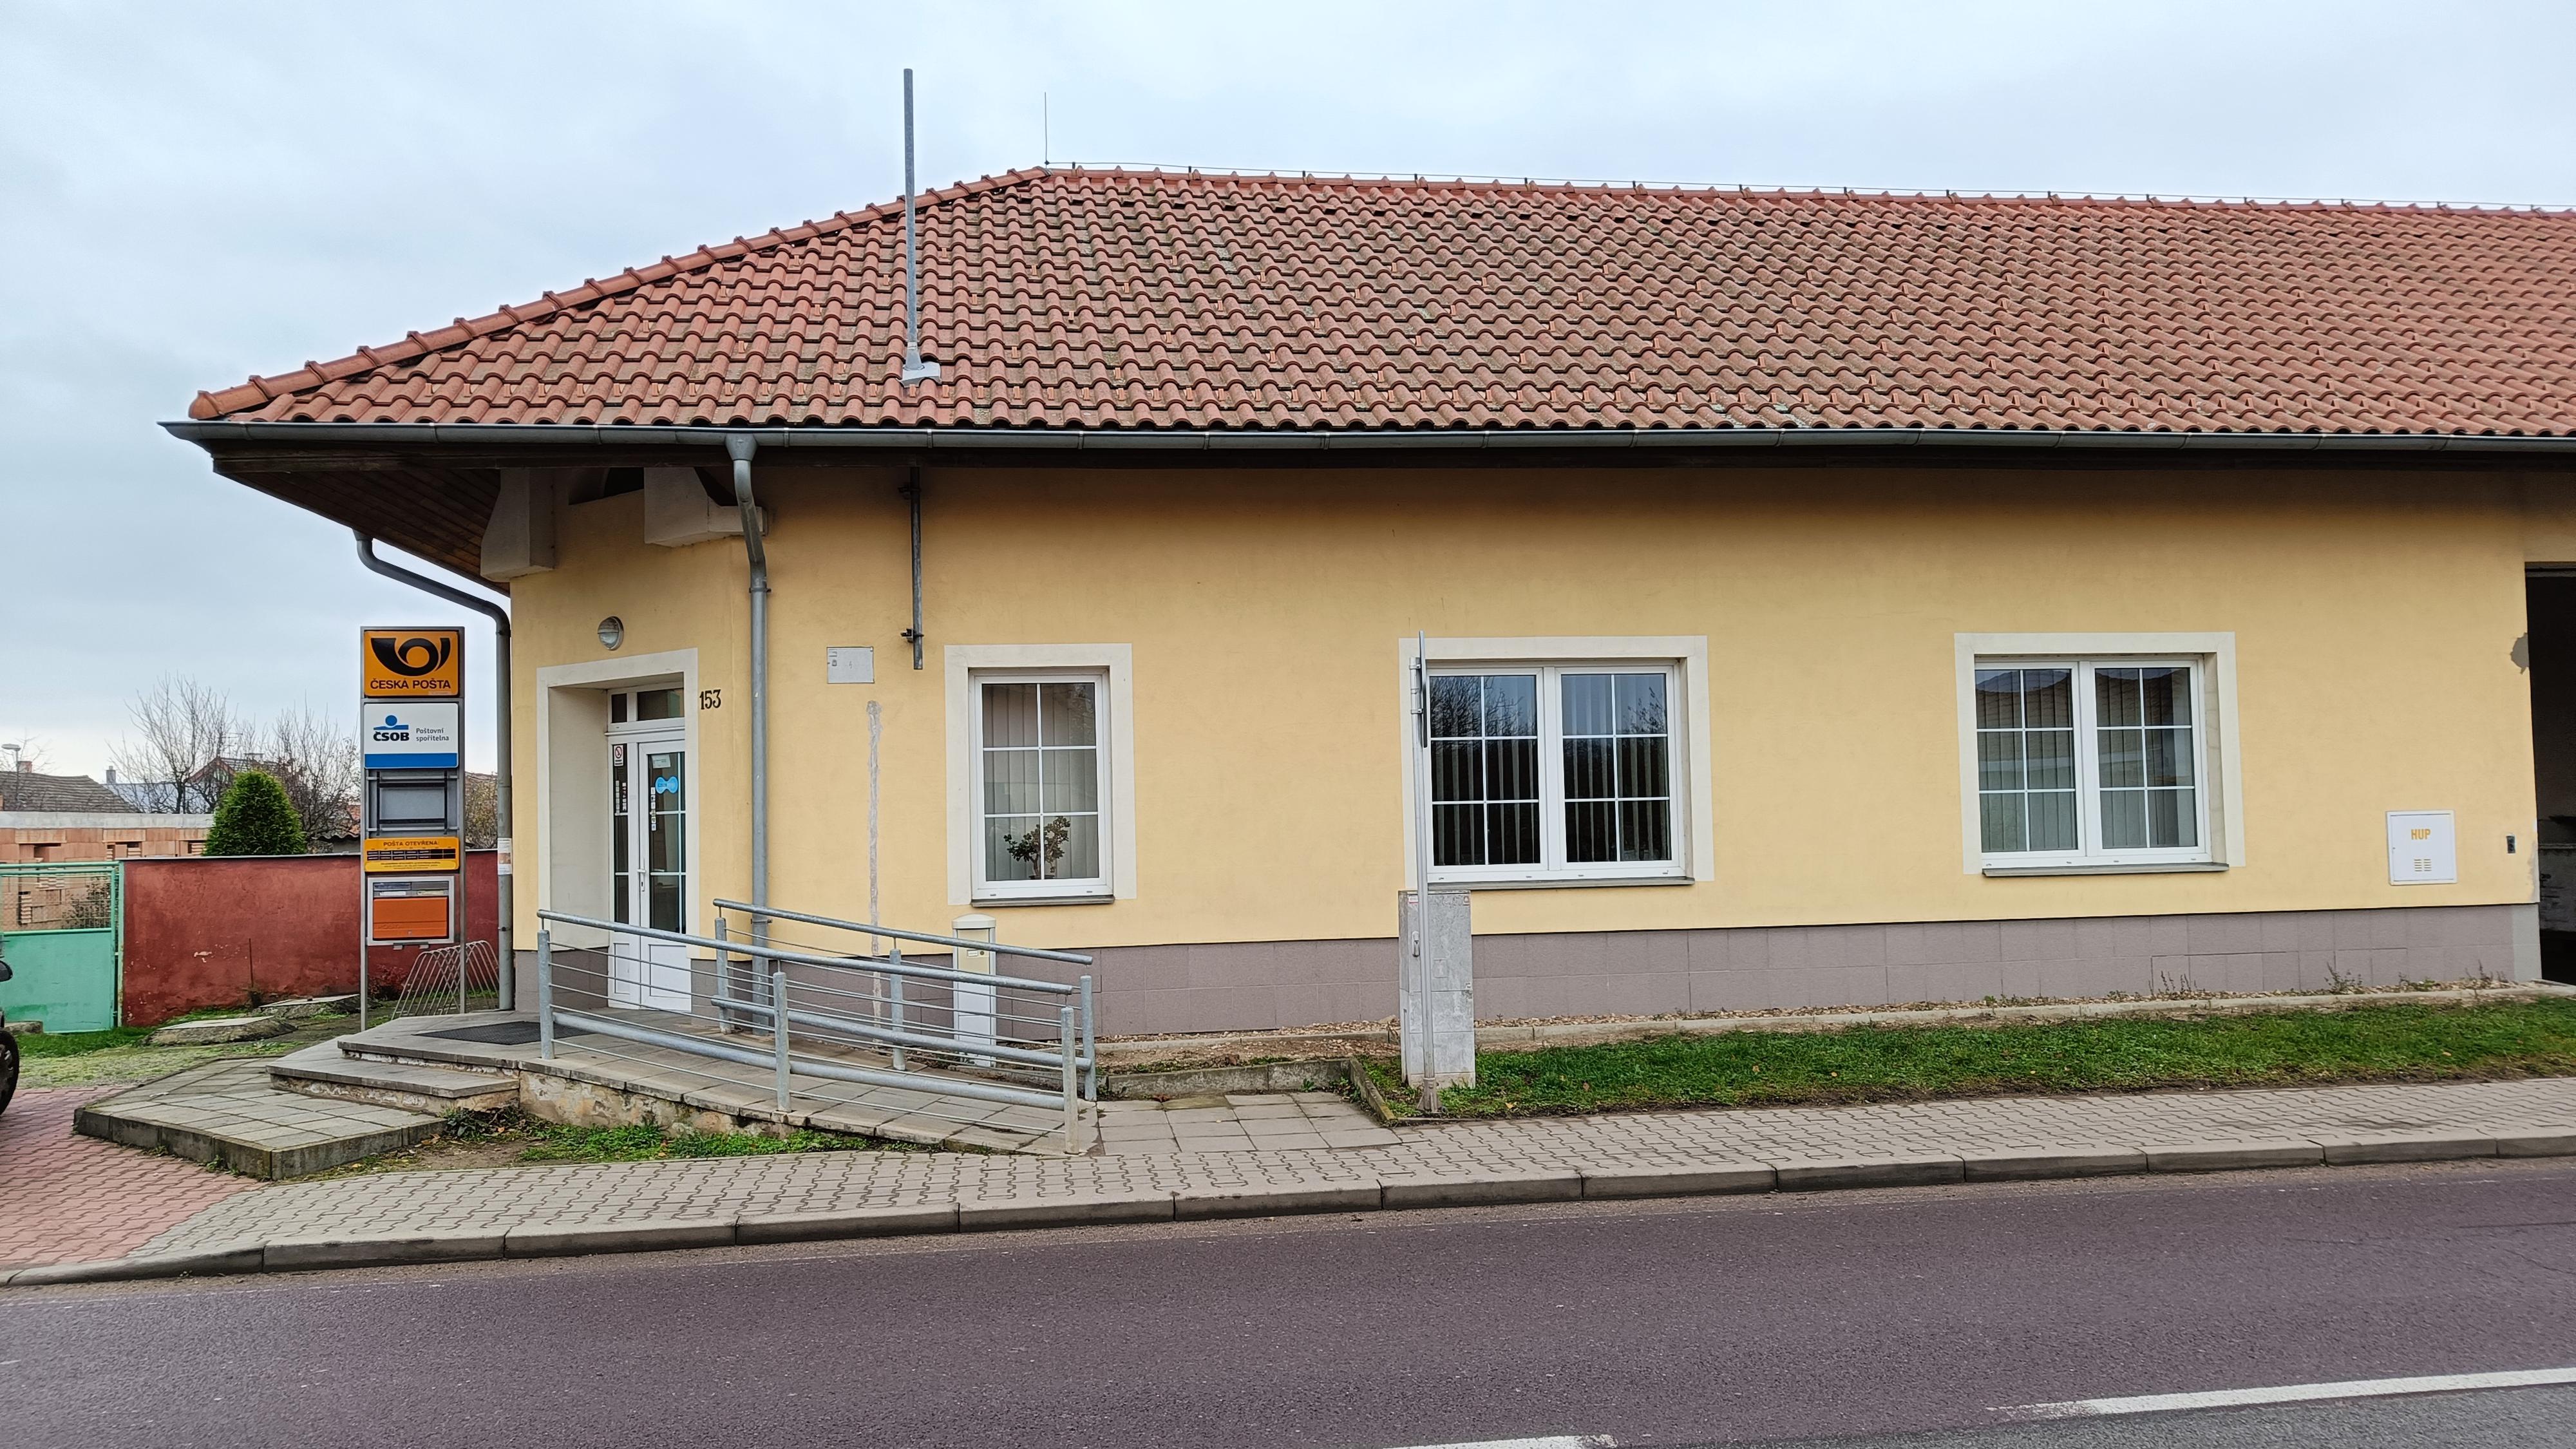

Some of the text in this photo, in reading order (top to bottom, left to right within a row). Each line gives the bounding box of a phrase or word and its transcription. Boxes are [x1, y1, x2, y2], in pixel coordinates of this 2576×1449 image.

[370, 678, 451, 689] ČESKÁ POŠTA
[699, 689, 721, 710] 153
[373, 731, 410, 741] ČSOB
[2410, 829, 2431, 840] HUP
